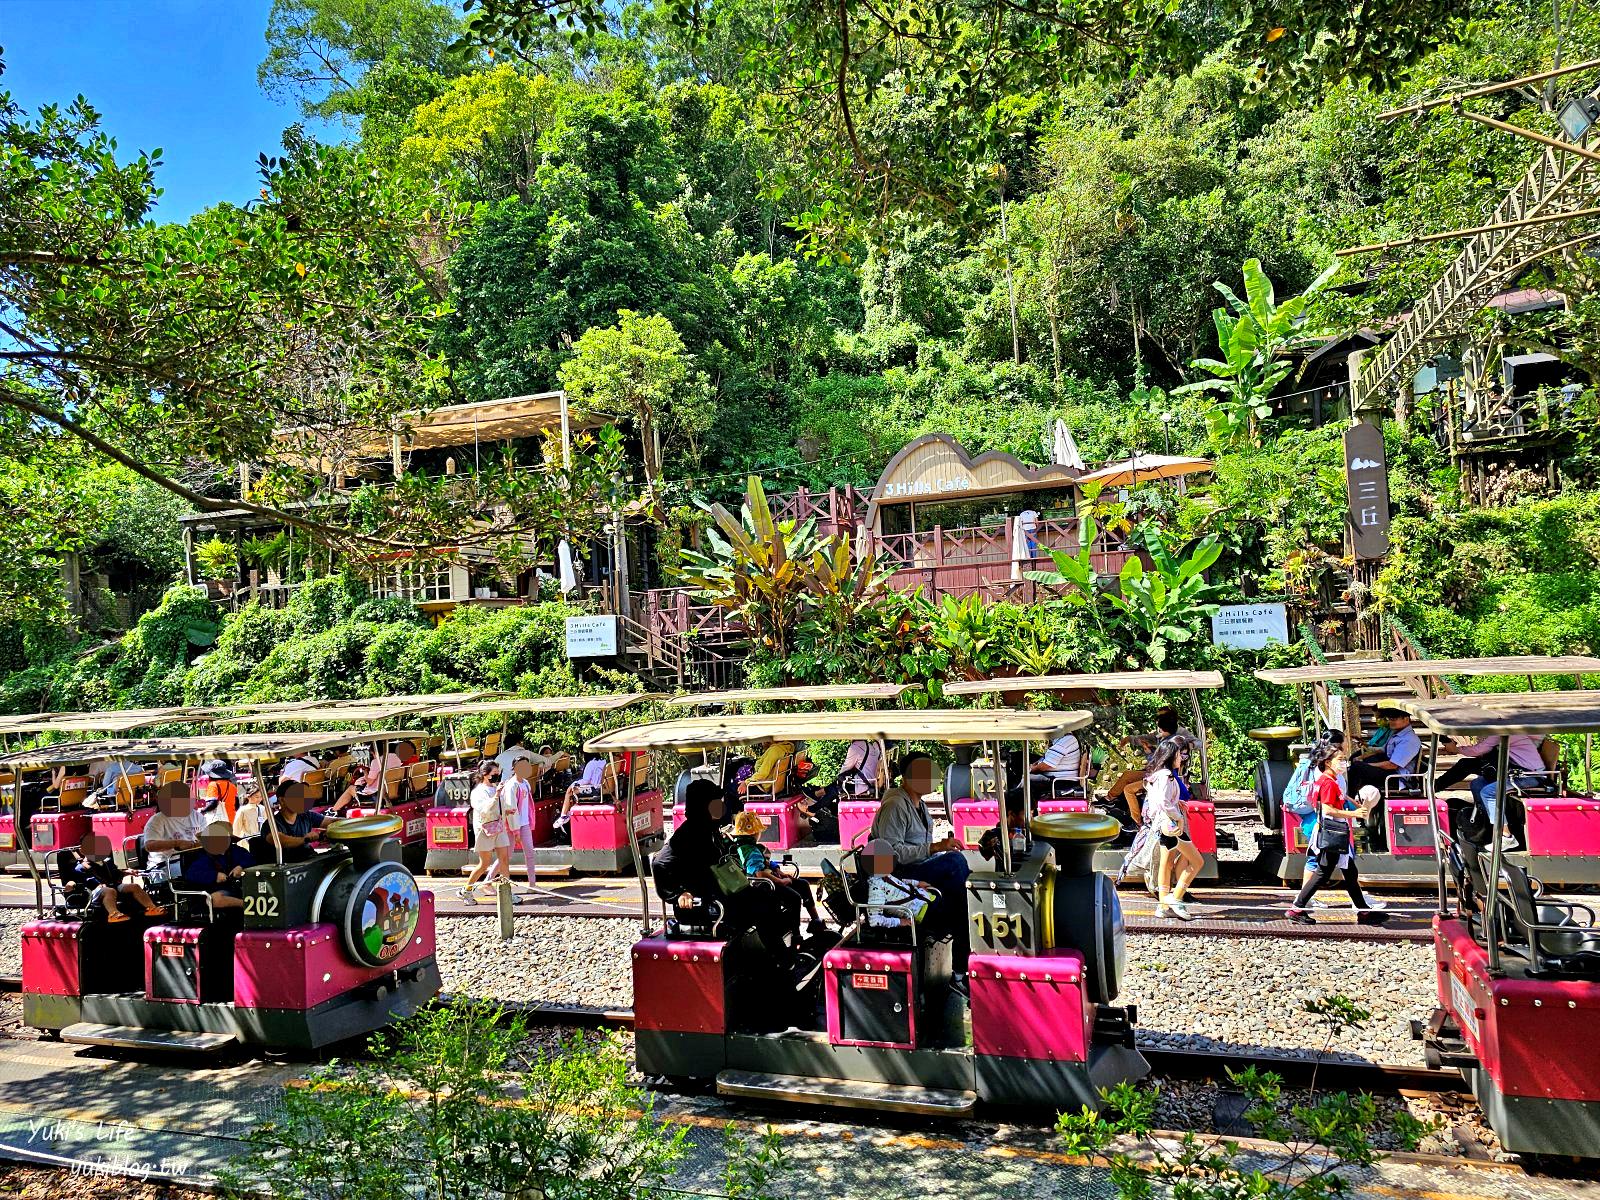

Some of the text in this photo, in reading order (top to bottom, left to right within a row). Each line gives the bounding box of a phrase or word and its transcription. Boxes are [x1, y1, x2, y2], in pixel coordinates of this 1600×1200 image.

[1359, 481, 1380, 526] 三丘
[447, 788, 469, 800] 199
[243, 895, 279, 917] 202
[971, 911, 1022, 938] 151
